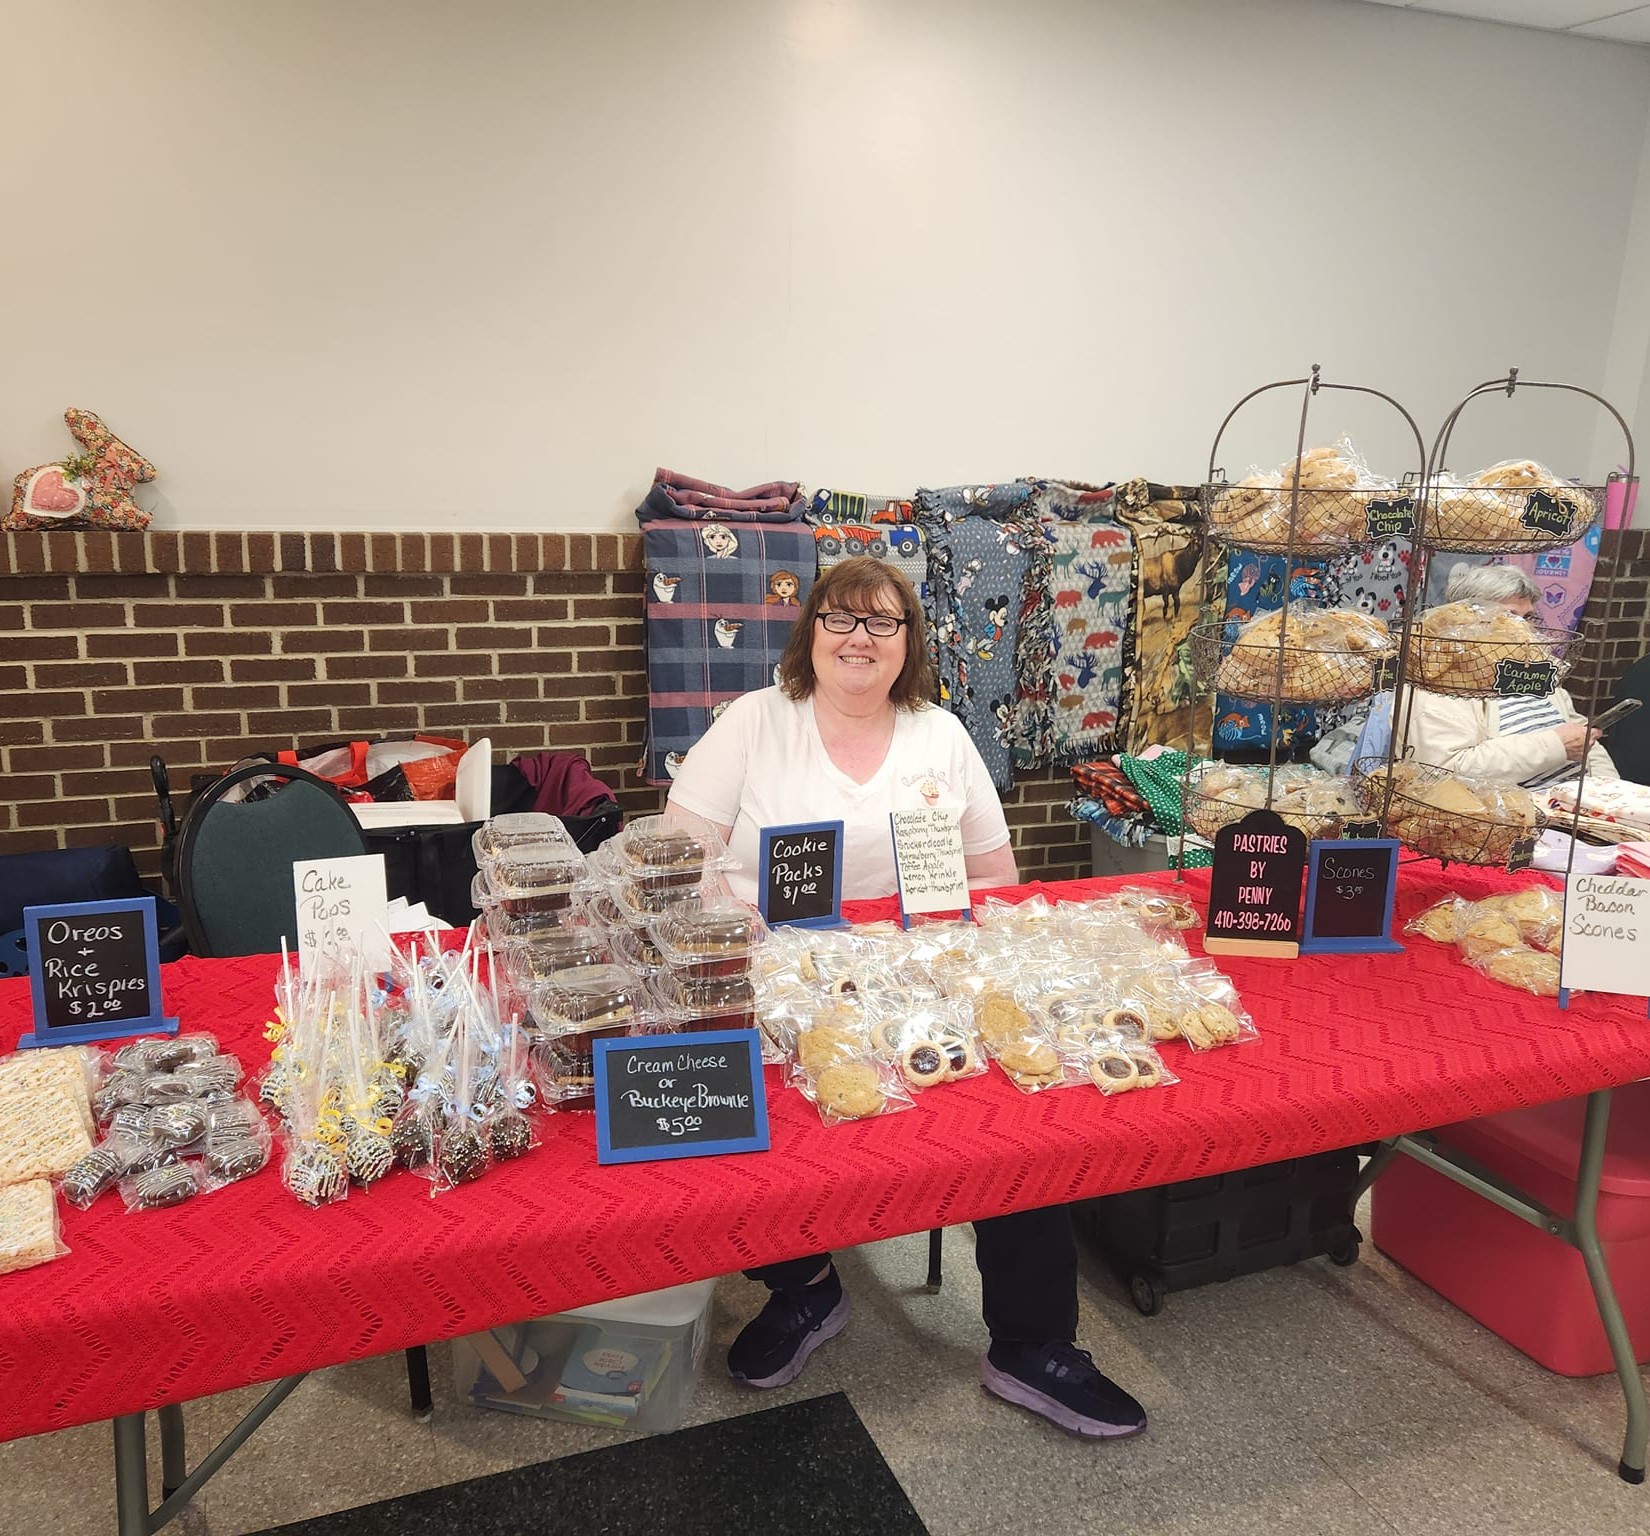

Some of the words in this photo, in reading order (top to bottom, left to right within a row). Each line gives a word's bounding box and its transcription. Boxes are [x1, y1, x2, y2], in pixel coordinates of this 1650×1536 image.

[1369, 506, 1412, 521] Chocolate
[1529, 501, 1570, 525] Apricot
[1376, 520, 1402, 532] Chip
[1503, 664, 1551, 682] Caramel
[1506, 678, 1543, 692] Apple
[894, 811, 927, 826] Chocolate
[931, 811, 949, 822] Chip
[773, 837, 829, 859] Cookie
[896, 836, 954, 850] Snickerdoodle
[1233, 834, 1288, 854] PASTRIES
[771, 862, 824, 885] Packs
[903, 871, 927, 881] Lemon
[1250, 861, 1267, 879] BY
[1322, 856, 1376, 880] Scones
[302, 869, 352, 893] Cake
[1576, 877, 1648, 897] Cheddar
[1238, 886, 1274, 906] PENNY
[1577, 894, 1635, 915] Bacon
[299, 894, 351, 921] Pops
[48, 920, 123, 944] Oreos
[1569, 912, 1638, 941] Scones
[44, 957, 100, 978] Rice
[58, 977, 146, 999] Krispies
[626, 1055, 674, 1074] Cream
[677, 1052, 728, 1072] Cheese
[658, 1078, 678, 1089] or
[620, 1089, 697, 1113] Buckeye
[692, 1083, 749, 1108] Brownie
